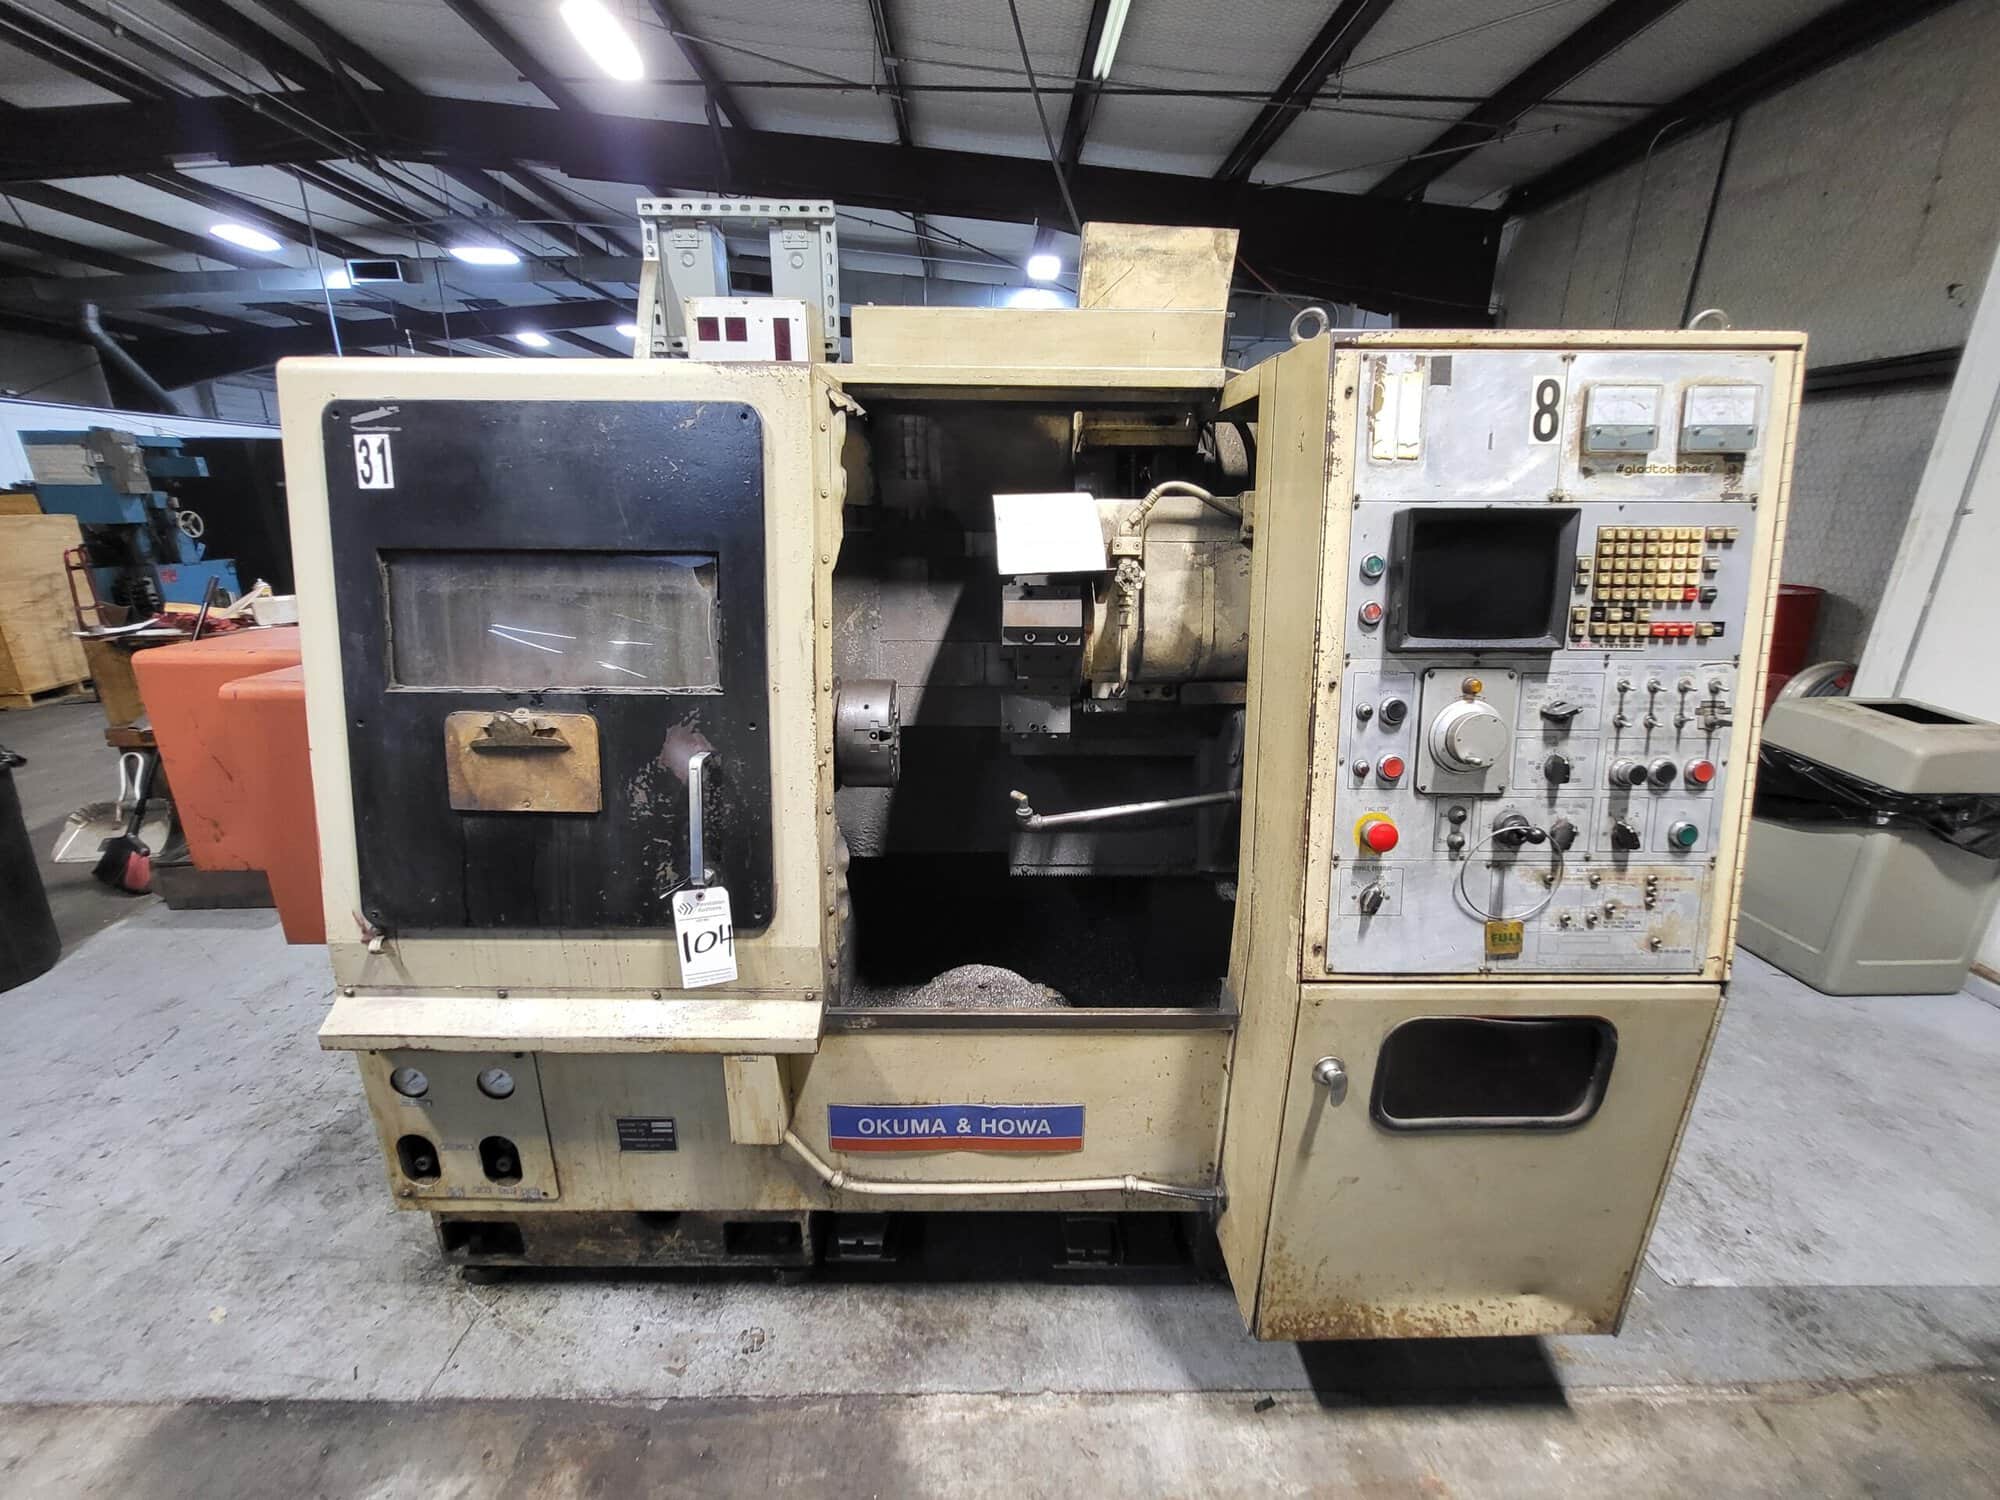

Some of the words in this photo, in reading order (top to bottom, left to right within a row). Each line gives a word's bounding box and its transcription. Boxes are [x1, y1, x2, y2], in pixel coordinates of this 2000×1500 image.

[1533, 378, 1561, 442] 8
[358, 438, 389, 485] 31
[683, 923, 735, 963] 104
[858, 1117, 947, 1135] OKUMA
[956, 1117, 972, 1134] &
[981, 1117, 1051, 1134] HOWA
